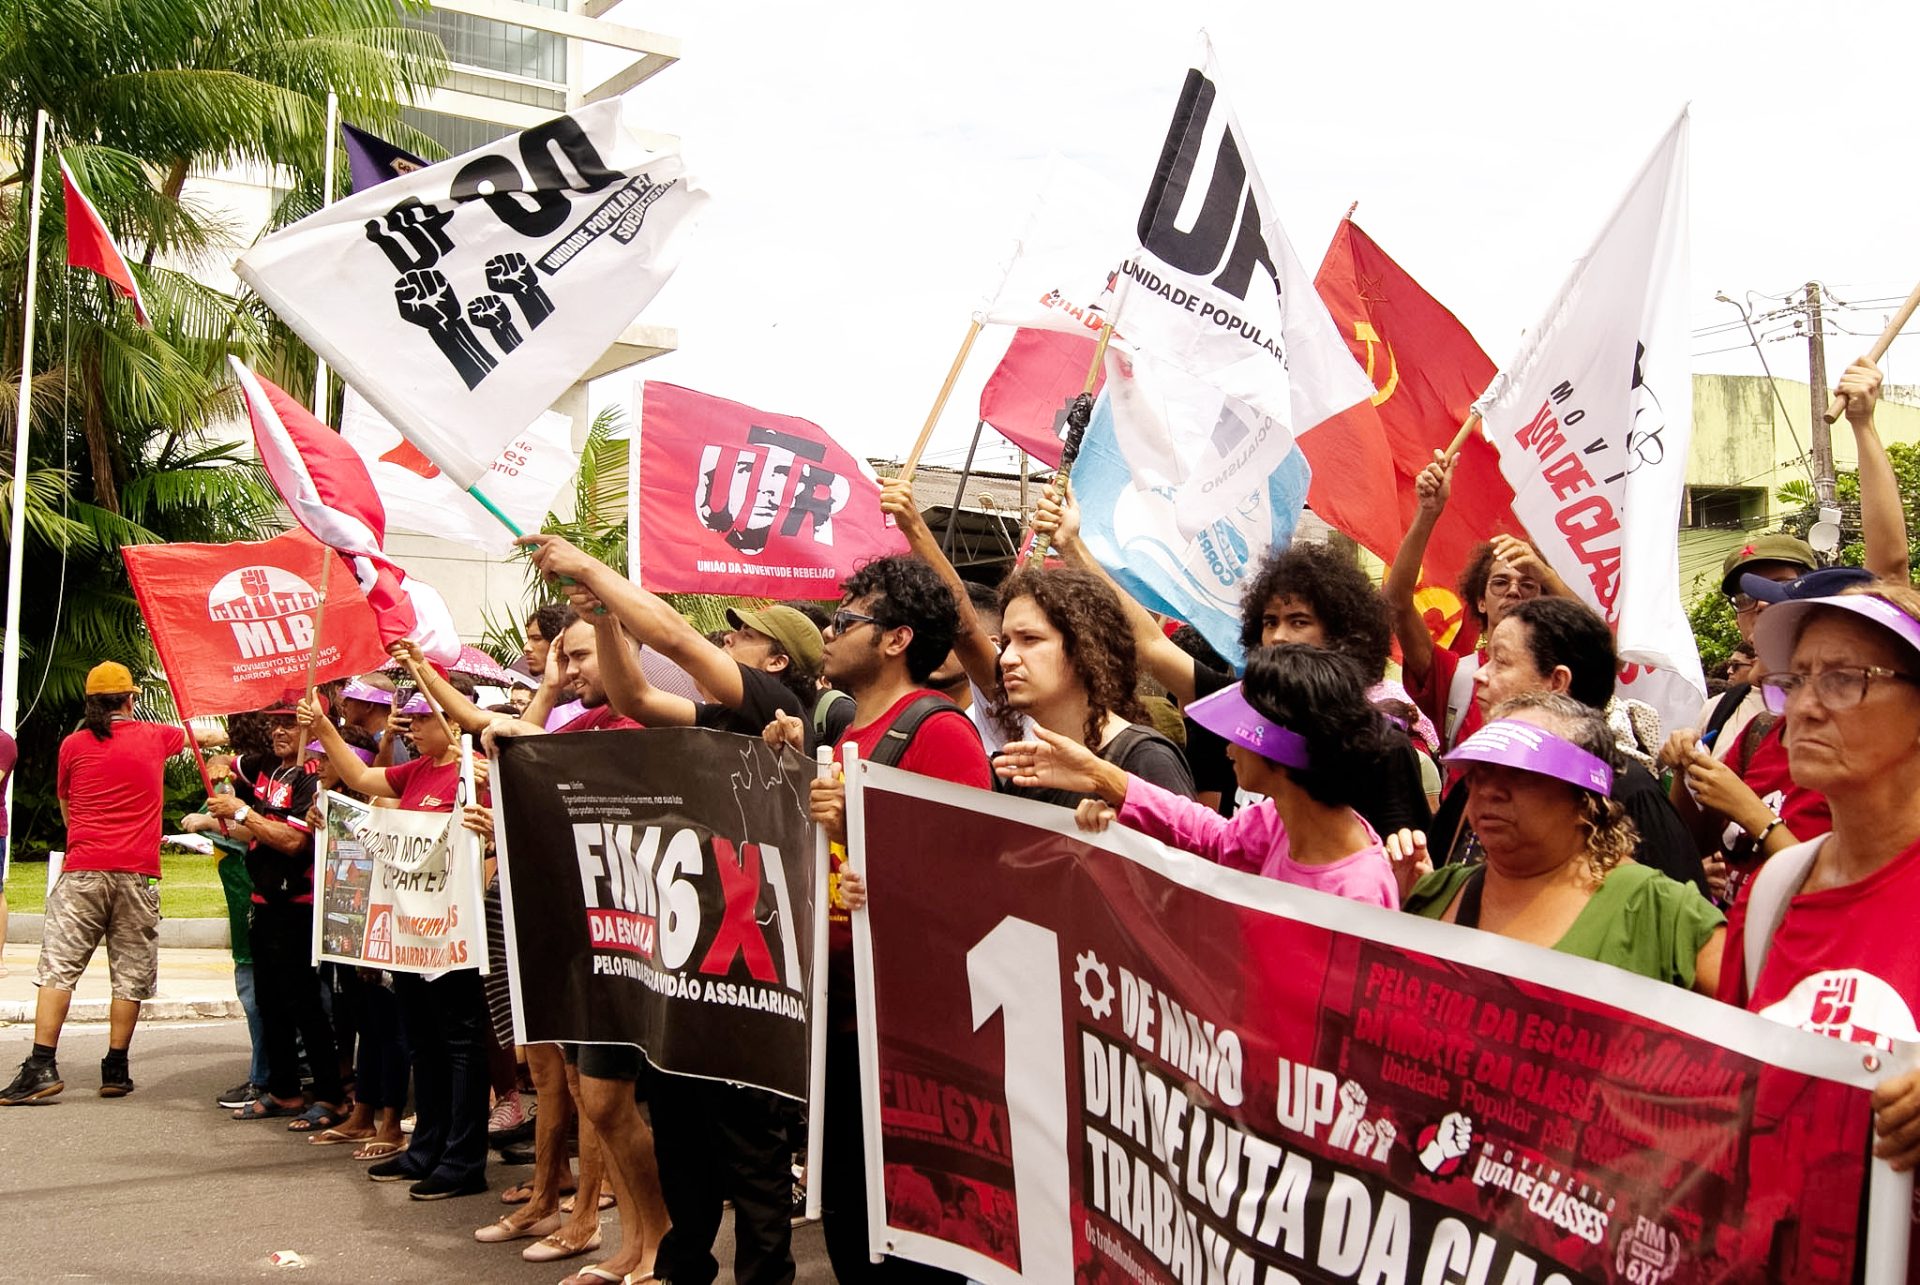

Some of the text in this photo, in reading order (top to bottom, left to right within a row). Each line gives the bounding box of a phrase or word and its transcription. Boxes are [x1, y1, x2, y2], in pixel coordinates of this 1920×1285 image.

[544, 229, 594, 268] UNIDADE
[585, 188, 639, 235] POPULAR
[1123, 260, 1282, 363] UNIDADE POPULAR
[1542, 452, 1596, 501] DE
[728, 562, 741, 574] DA
[742, 563, 792, 579] JUVENTUDE
[230, 614, 315, 659] MLB
[233, 645, 337, 673] MOVIMENTO DE LUT NOS
[275, 664, 298, 675] VILAS
[300, 662, 306, 671] E
[572, 822, 660, 917] FIM
[590, 915, 618, 944] DA
[593, 955, 622, 977] PELO
[703, 980, 806, 1023] ASSALARIADA
[1366, 963, 1421, 1007] PELO
[1424, 982, 1477, 1029] FIM
[1478, 1001, 1518, 1045] DA
[966, 915, 1244, 1285] 1 DE MAIO
[1277, 1057, 1337, 1138] UP
[1355, 1008, 1384, 1046] DA
[1475, 1050, 1512, 1089] DA
[1513, 1061, 1599, 1122] CLASSE
[1381, 1055, 1449, 1099] Unidade
[1461, 1080, 1538, 1134] Popular
[1083, 1030, 1147, 1148] DIA
[1144, 1070, 1188, 1185] DE
[1186, 1105, 1312, 1259] LUTA
[1317, 1171, 1412, 1285] DA
[1483, 1142, 1616, 1212] MOVIMENTO
[1085, 1219, 1096, 1245] Os
[1472, 1156, 1608, 1244] LUTA DE CLASSES
[1634, 1215, 1666, 1250] FIM
